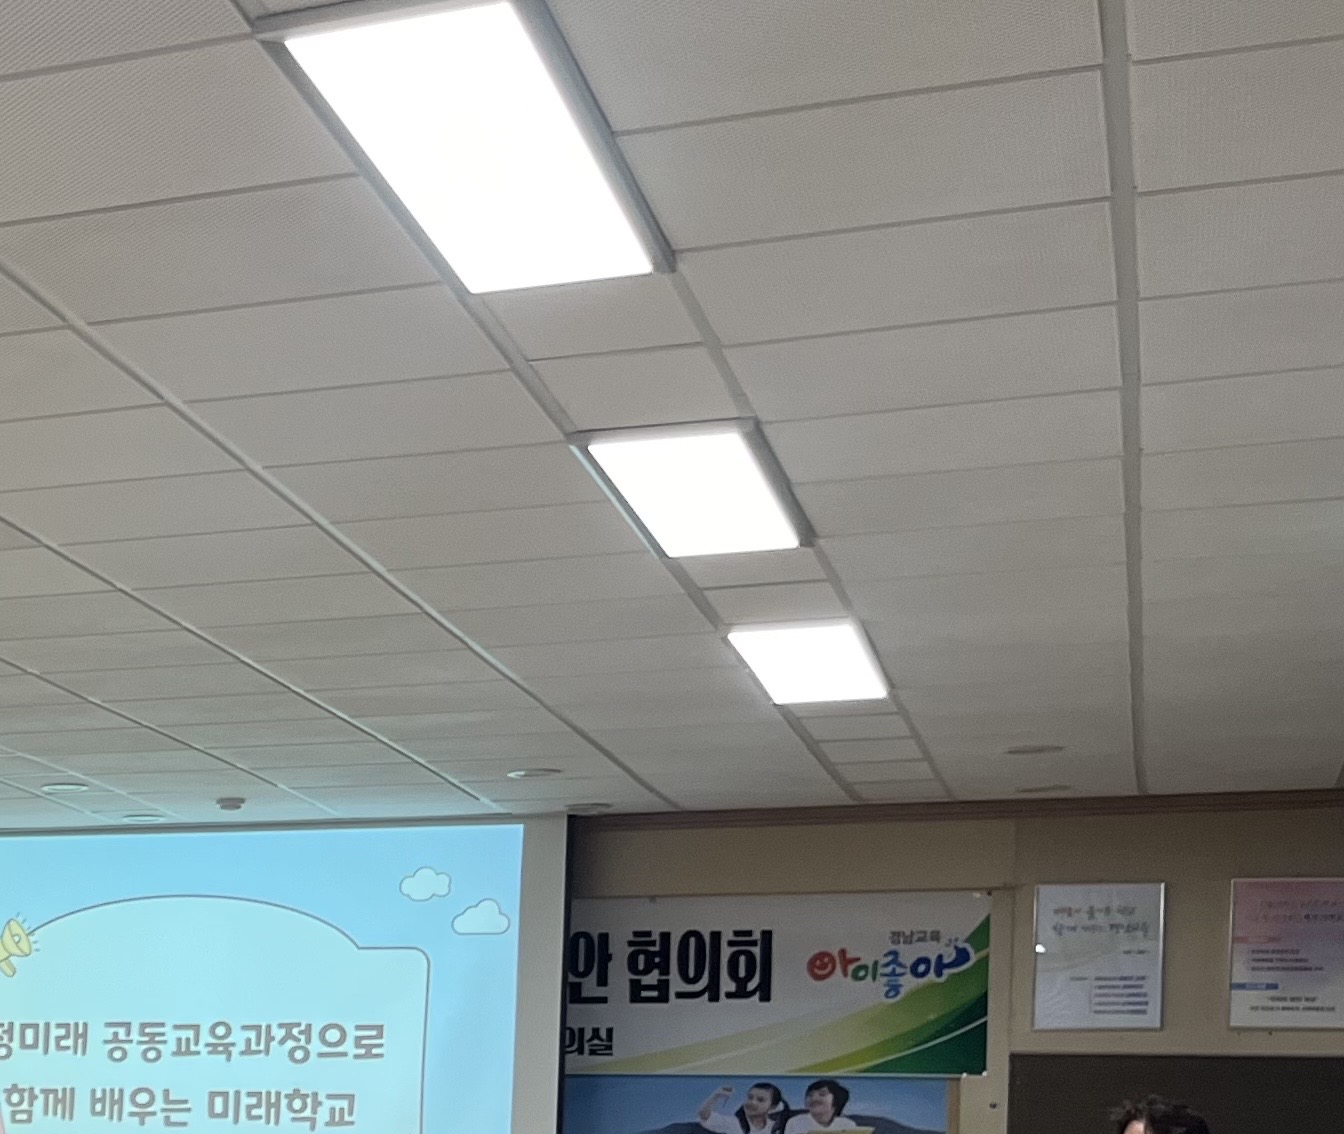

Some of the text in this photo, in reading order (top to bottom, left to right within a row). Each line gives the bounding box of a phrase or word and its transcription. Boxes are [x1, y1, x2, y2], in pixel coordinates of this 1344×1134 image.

[889, 930, 941, 945] 경남교육
[627, 930, 772, 1004] 협의회
[806, 947, 971, 999] 아이좋아
[102, 1020, 385, 1065] 공동교육과정으로
[2, 1083, 356, 1132] 함께 배우는 미래학교
